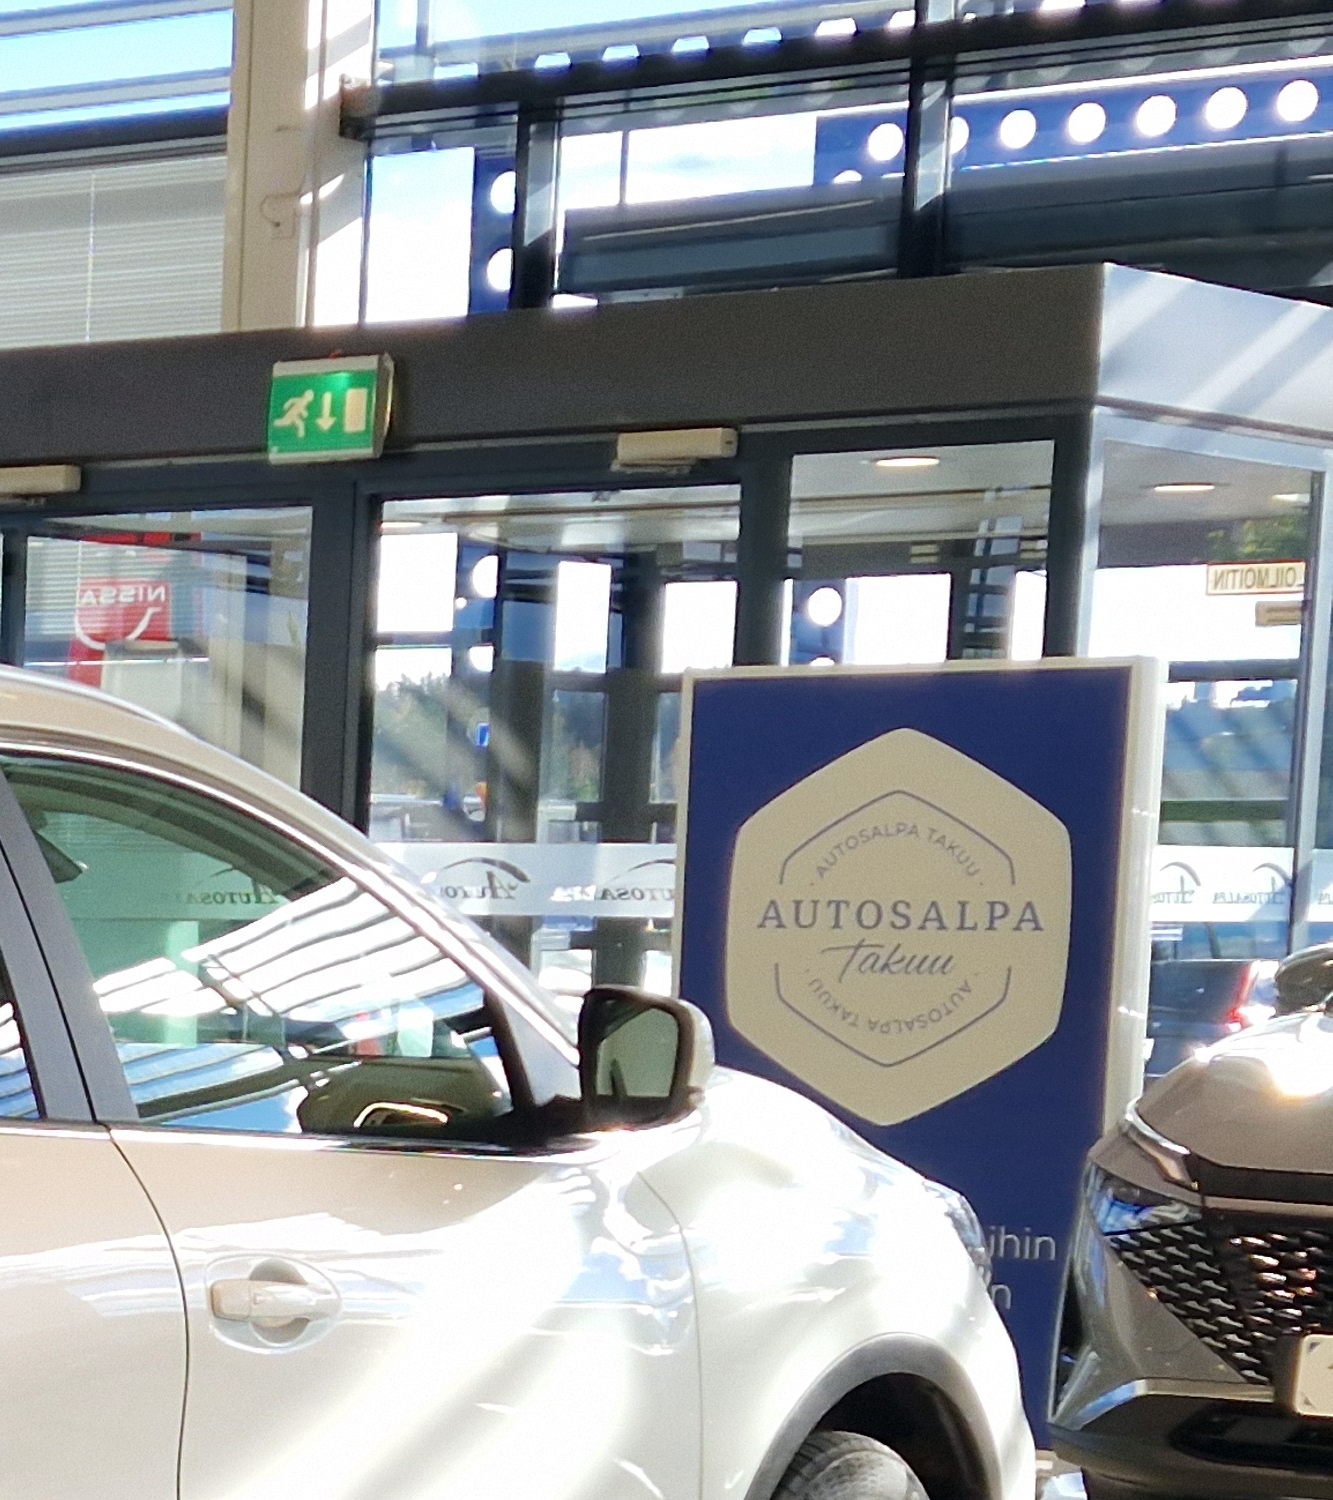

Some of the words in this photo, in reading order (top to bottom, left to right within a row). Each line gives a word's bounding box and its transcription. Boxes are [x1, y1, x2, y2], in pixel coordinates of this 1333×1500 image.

[816, 821, 919, 878] AUTOSALPA
[927, 827, 981, 877] TAKUU
[756, 899, 1045, 932] AUTOSALPA
[820, 938, 955, 983] Takuu
[808, 977, 859, 1029] TAKUU
[868, 979, 973, 1034] AUTOSALPA
